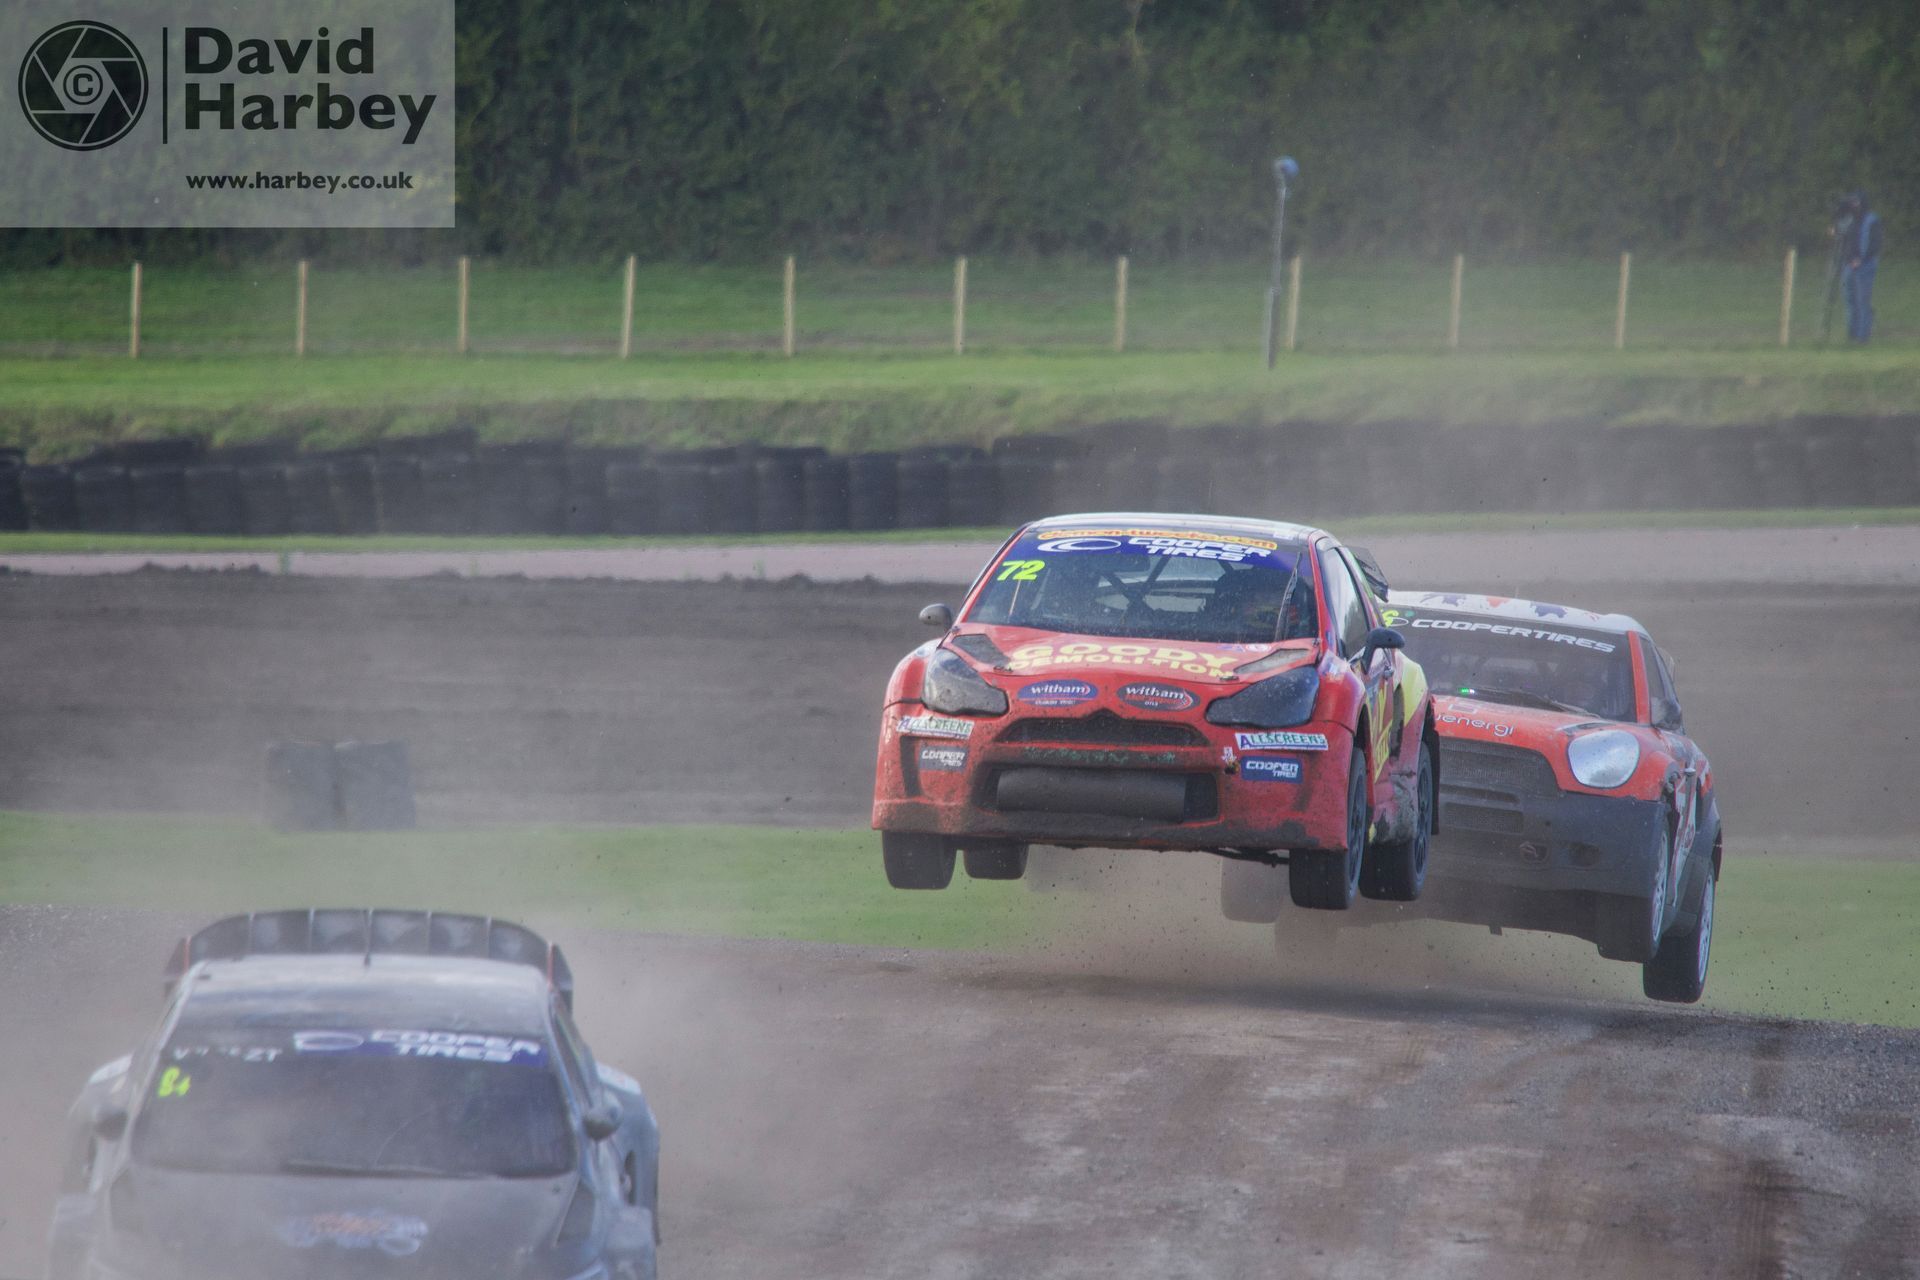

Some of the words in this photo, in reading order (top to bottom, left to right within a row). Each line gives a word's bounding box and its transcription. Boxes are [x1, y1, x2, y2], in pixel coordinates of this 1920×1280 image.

[1128, 537, 1272, 557] COOPER
[1146, 545, 1247, 561] TIRES
[997, 560, 1046, 581] 72
[1011, 644, 1238, 668] GOODY
[1008, 655, 1234, 678] DEMOLITION
[1031, 682, 1086, 695] witham
[1126, 685, 1185, 700] witham
[1246, 761, 1299, 771] COOPER
[371, 1030, 541, 1055] COOPER
[396, 1042, 514, 1063] TIRES
